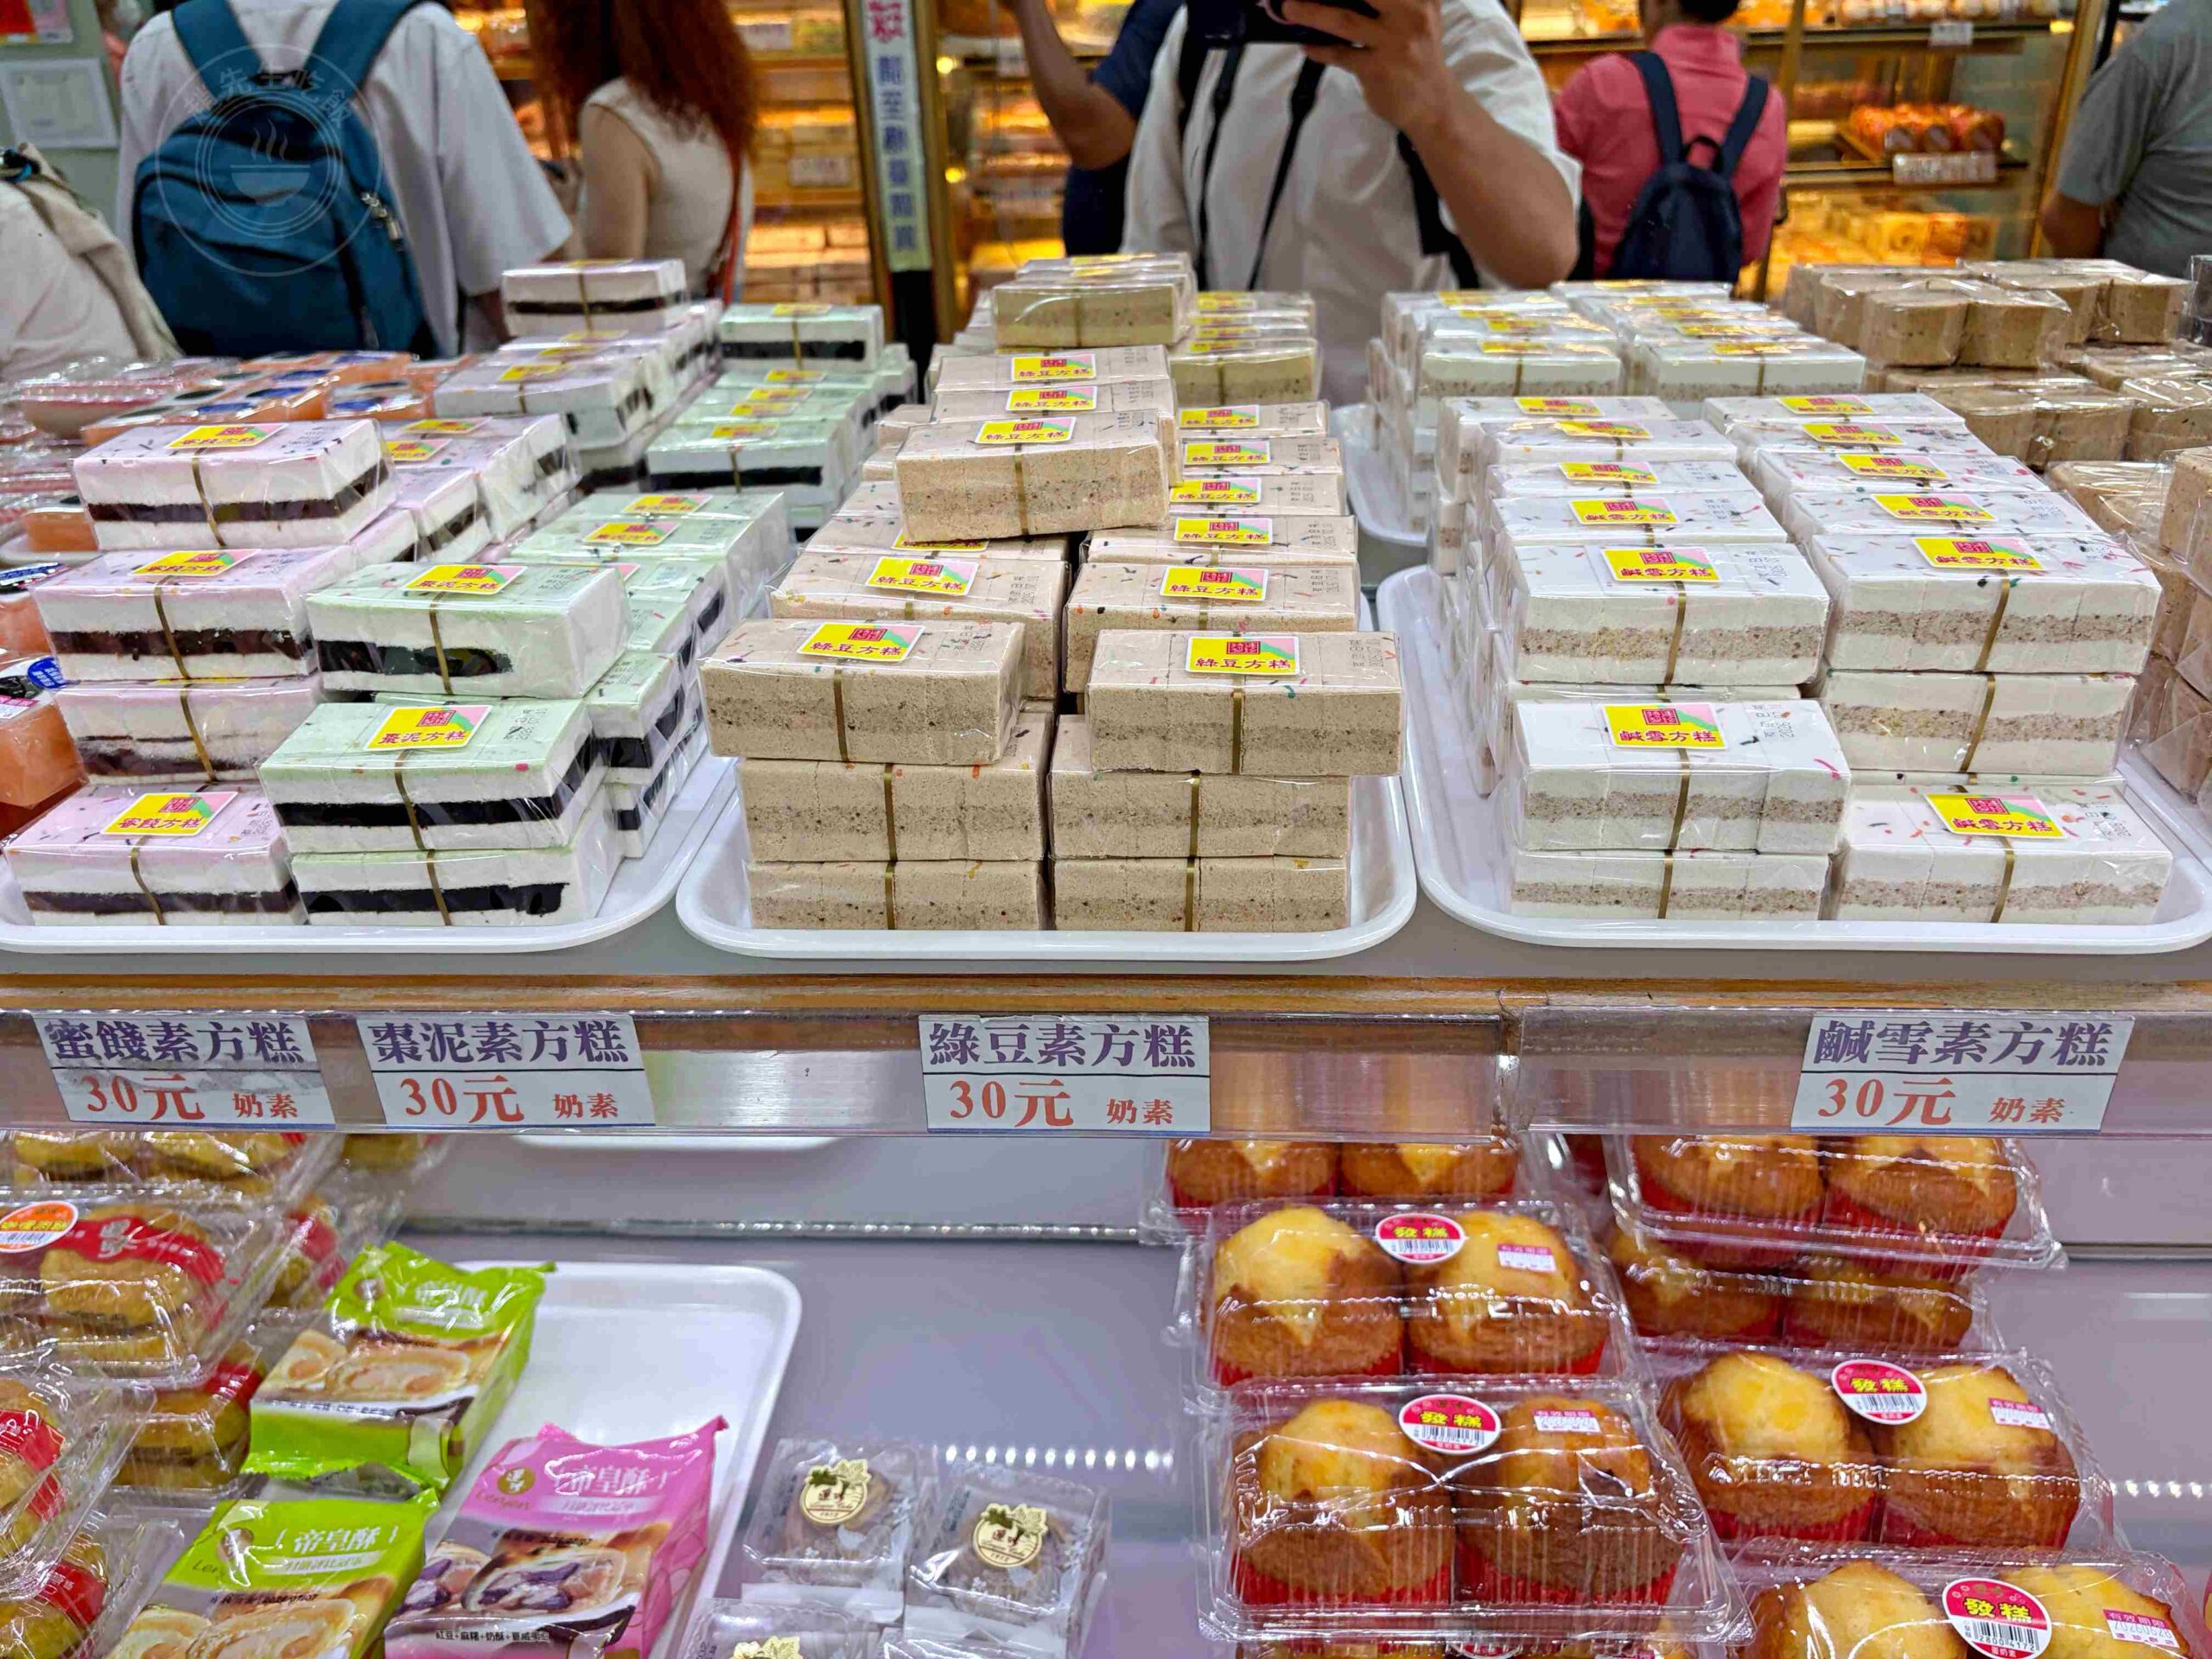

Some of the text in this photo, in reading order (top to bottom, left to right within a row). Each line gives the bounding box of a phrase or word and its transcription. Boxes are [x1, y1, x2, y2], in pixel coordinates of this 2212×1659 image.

[1183, 531, 1265, 540] 綠豆方糕
[1935, 555, 2035, 567] 鹹雪方糕
[875, 575, 963, 591] 綠豆方糕
[1620, 567, 1712, 578] 鹹雪方糕
[1169, 584, 1259, 596] 綠豆方糕
[809, 642, 902, 657] 綠豆方糕
[1195, 657, 1292, 670] 綠豆方糕
[1619, 729, 1718, 743] 鹹雪方糕
[1952, 817, 2053, 834] 鹹雪方糕
[44, 1019, 305, 1064] 蜜餞素方糕
[368, 1020, 629, 1064] 棗泥素方糕
[929, 1023, 1196, 1068] 綠豆素方糕
[1813, 1020, 2113, 1067] 鹹雪素方糕
[81, 1073, 298, 1121] 30元 奶素
[399, 1075, 619, 1123] 30元 奶素
[950, 1079, 1173, 1128] 30元 奶素
[1818, 1077, 2066, 1126] 30元 奶素
[1964, 1598, 2033, 1624] 發糕
